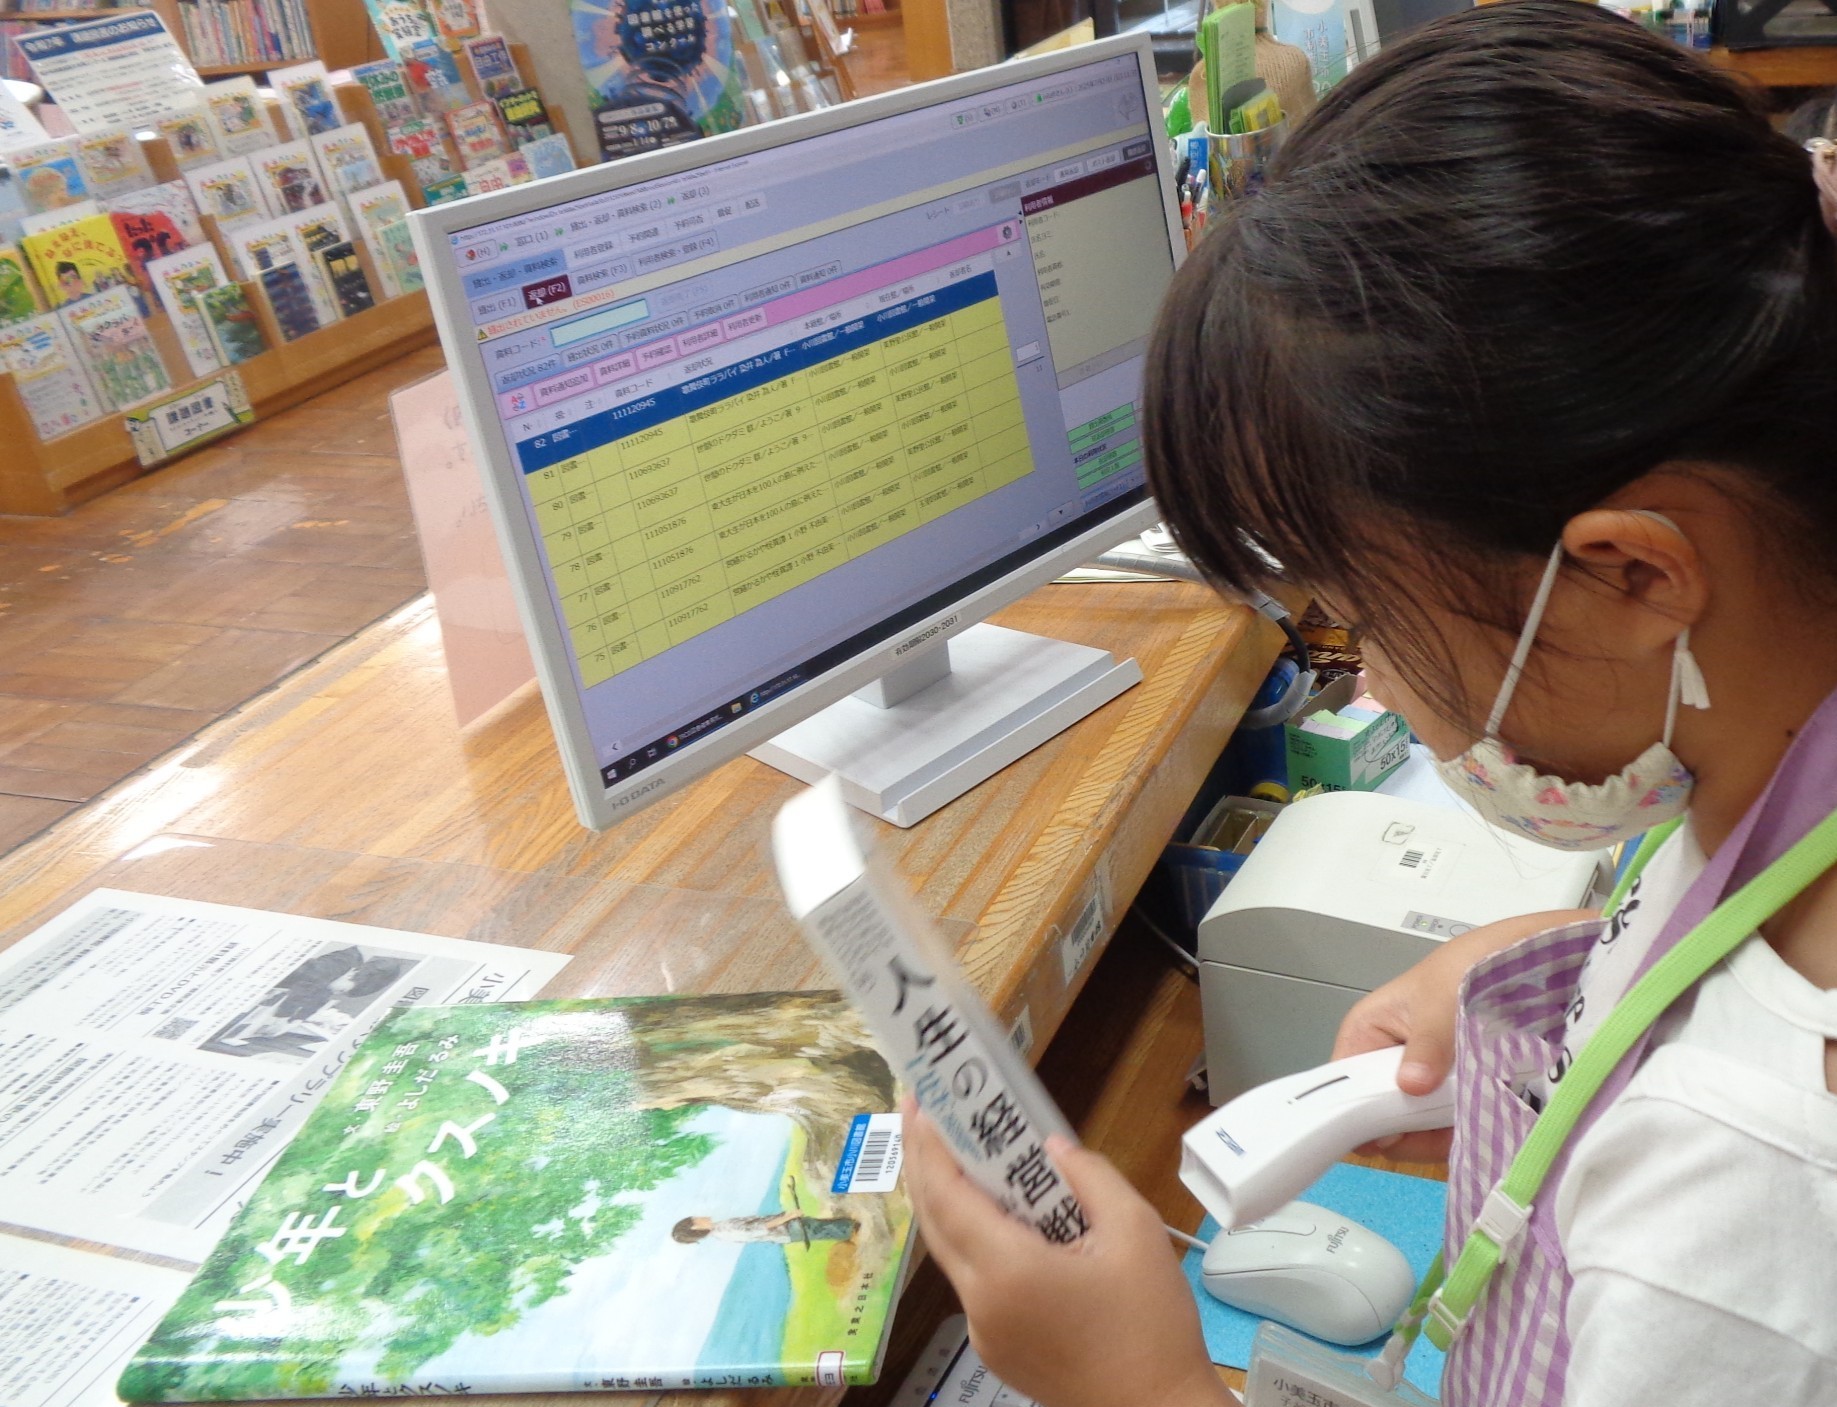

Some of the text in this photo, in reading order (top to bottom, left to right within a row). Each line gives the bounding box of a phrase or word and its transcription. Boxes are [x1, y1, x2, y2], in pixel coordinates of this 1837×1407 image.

[533, 436, 547, 450] 82
[542, 468, 556, 481] 81
[550, 499, 564, 513] 80
[559, 530, 573, 544] 79
[568, 561, 582, 574] 78
[576, 590, 590, 605] 77
[585, 621, 598, 635] 76
[593, 650, 607, 664] 75
[400, 1027, 550, 1206] クスノキ
[1326, 1225, 1350, 1255] FUJITSU
